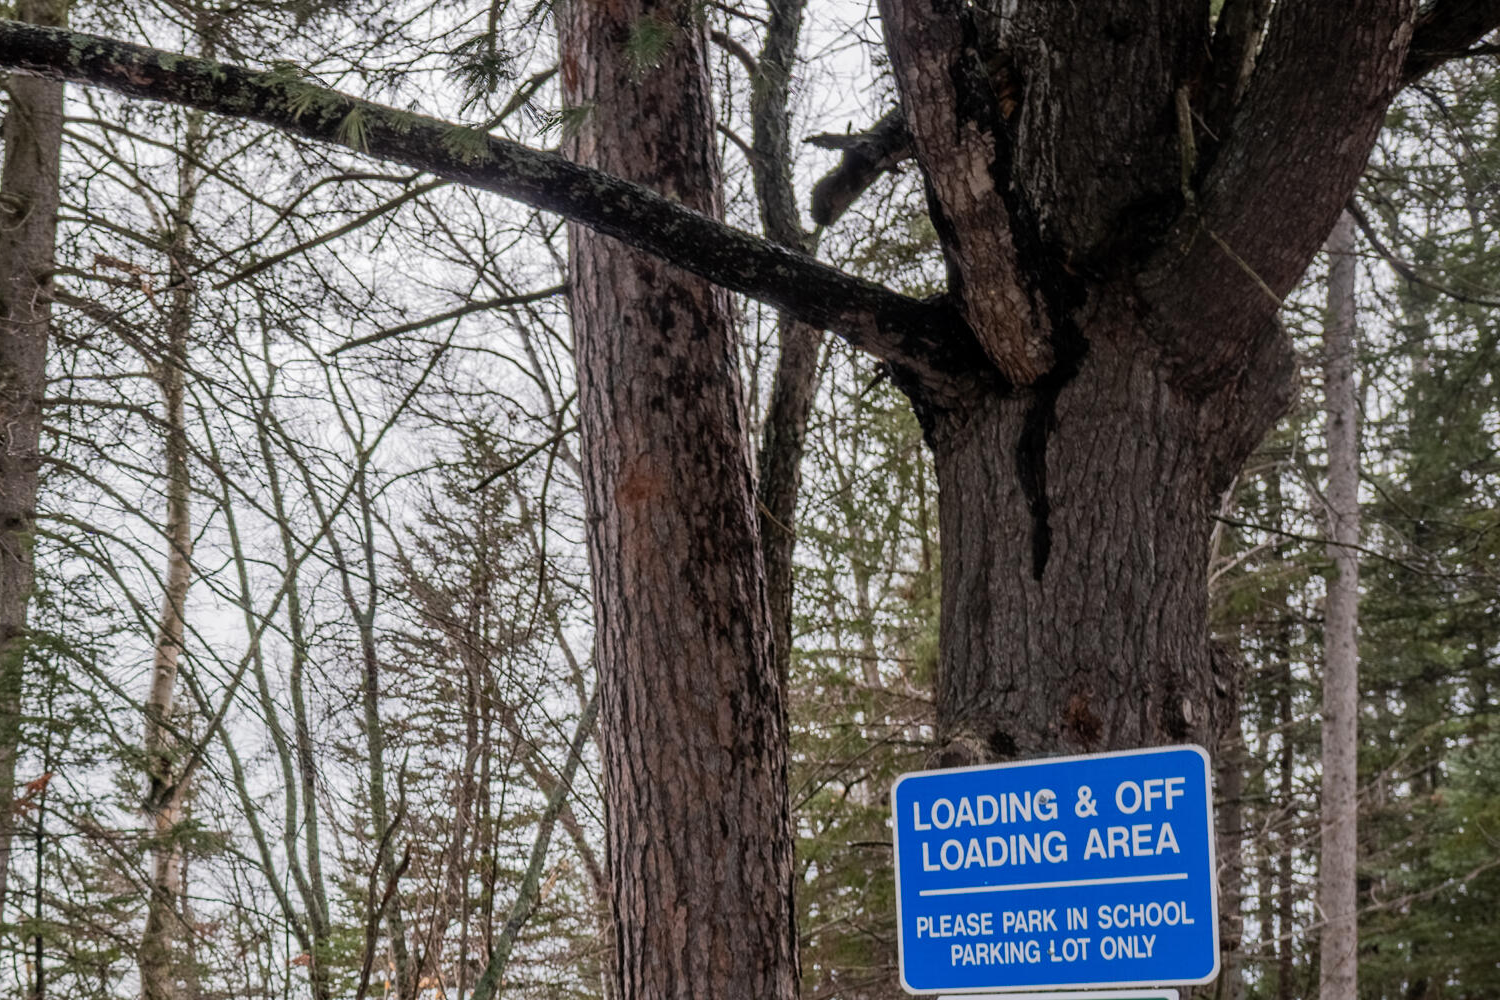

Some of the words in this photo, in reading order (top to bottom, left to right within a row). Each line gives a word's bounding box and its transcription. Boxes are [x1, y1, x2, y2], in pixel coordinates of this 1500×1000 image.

[913, 789, 1059, 831] LOADING
[1074, 785, 1098, 818] &
[1115, 777, 1185, 815] OFF
[922, 831, 1068, 872] LOADING
[1083, 822, 1180, 860] AREA
[916, 913, 993, 938] PLEASE
[1003, 909, 1058, 934] PARK
[1067, 907, 1088, 931] IN
[1098, 901, 1194, 929] SCHOOL
[951, 940, 1040, 966] PARKING
[1050, 938, 1091, 962] LOT
[1100, 934, 1157, 960] ONLY
